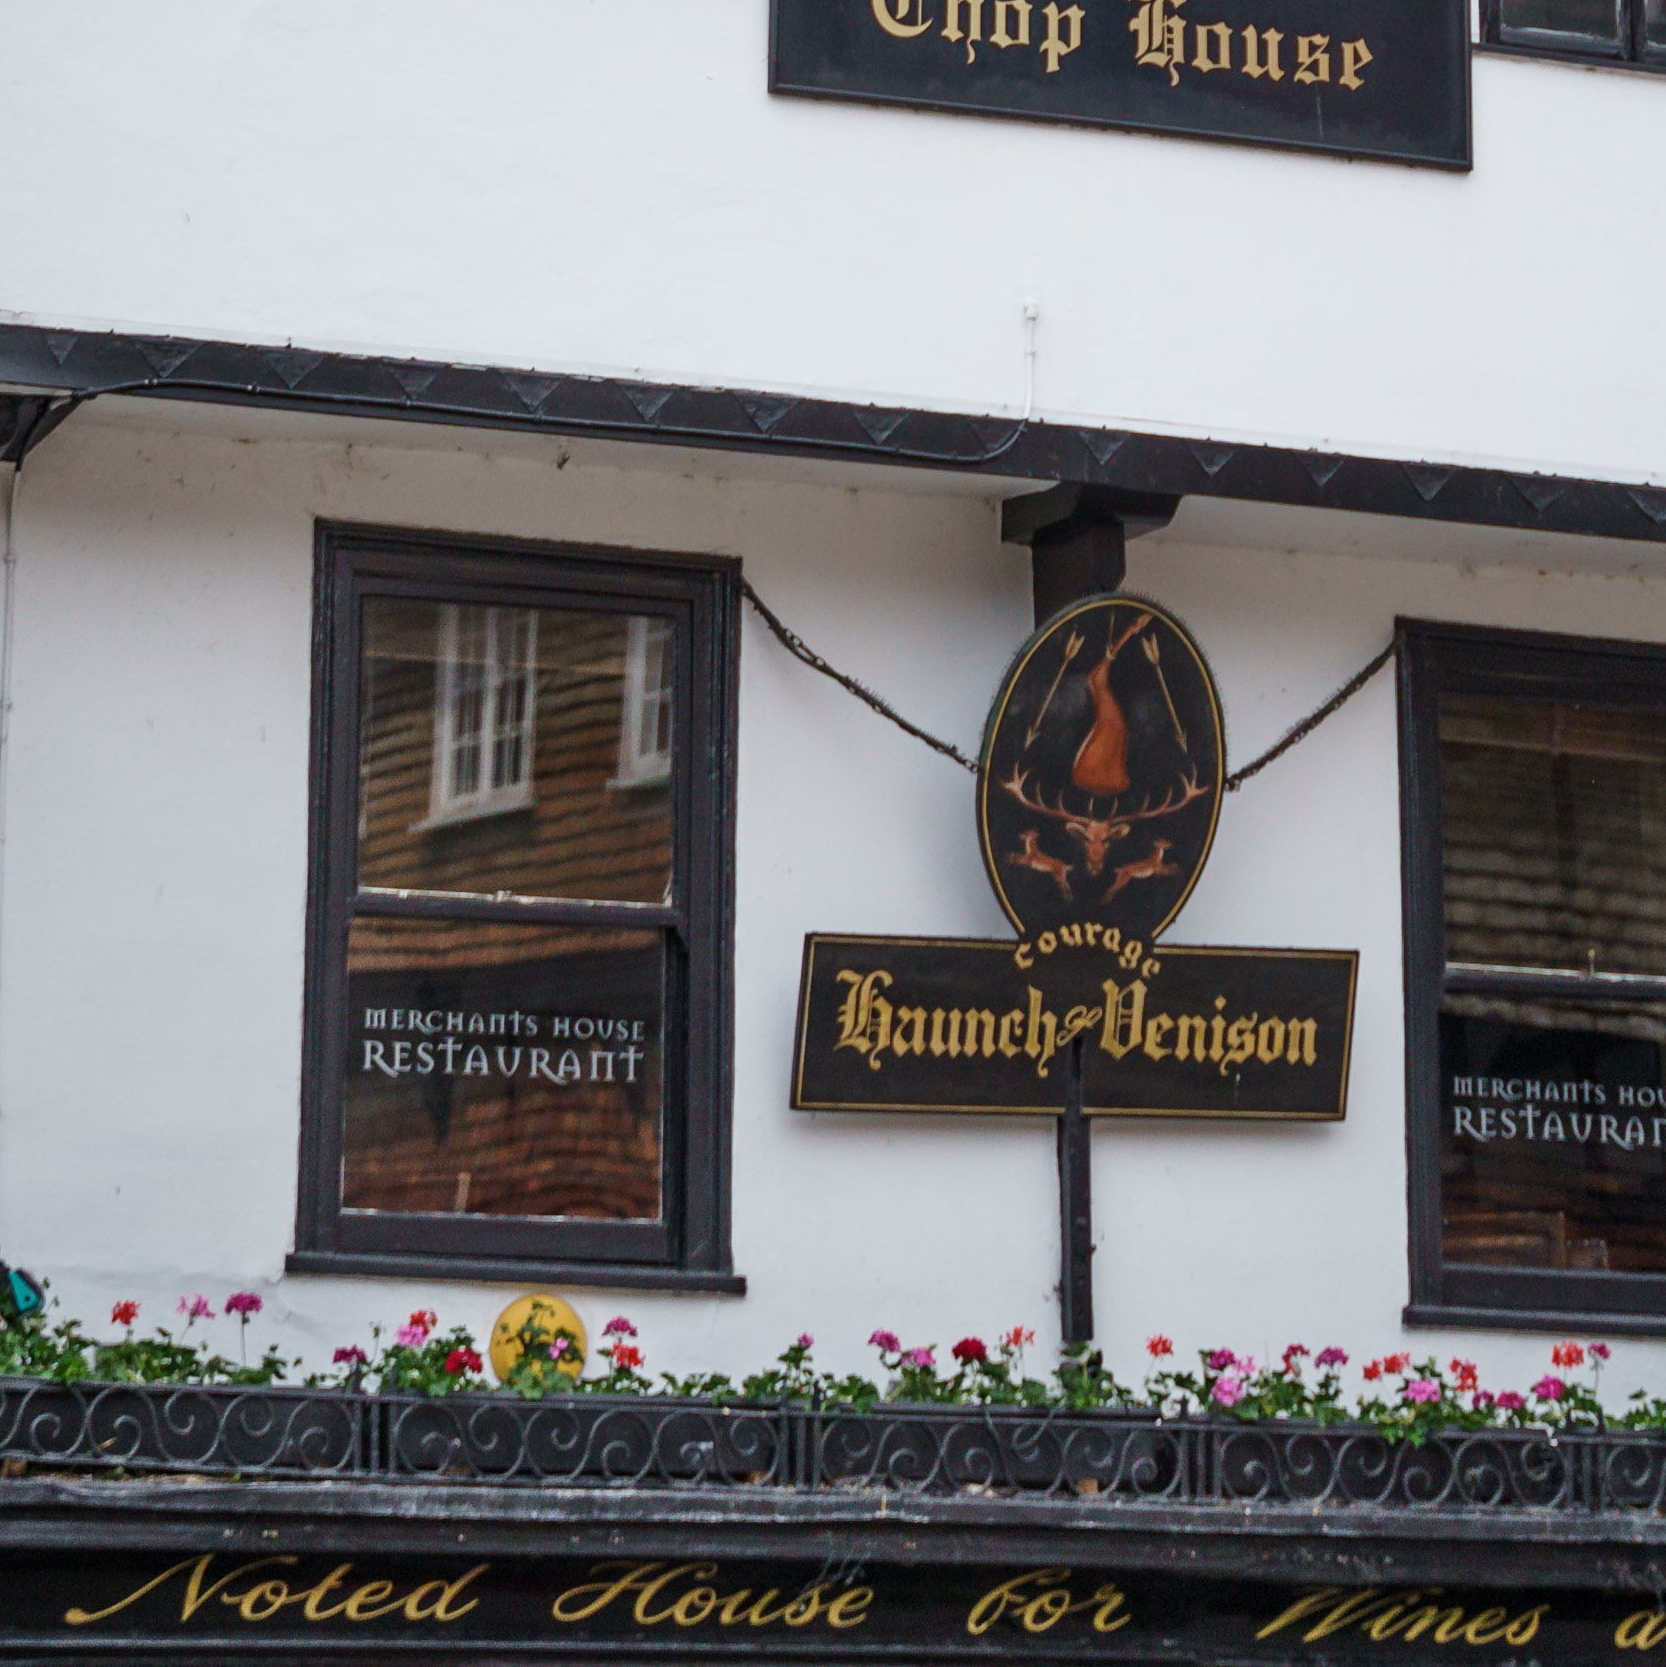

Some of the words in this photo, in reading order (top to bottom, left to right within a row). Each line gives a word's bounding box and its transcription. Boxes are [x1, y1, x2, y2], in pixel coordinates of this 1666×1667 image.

[364, 1008, 538, 1037] MERCHANTS
[552, 1016, 645, 1042] HOUSE
[834, 969, 1056, 1078] Haunch
[1099, 977, 1318, 1076] Venison
[362, 1036, 645, 1085] RESTAURANT
[1453, 1076, 1606, 1104] MERCHANTS
[64, 1553, 491, 1625] Noted
[552, 1561, 875, 1628] House
[1255, 1587, 1551, 1646] Wines
